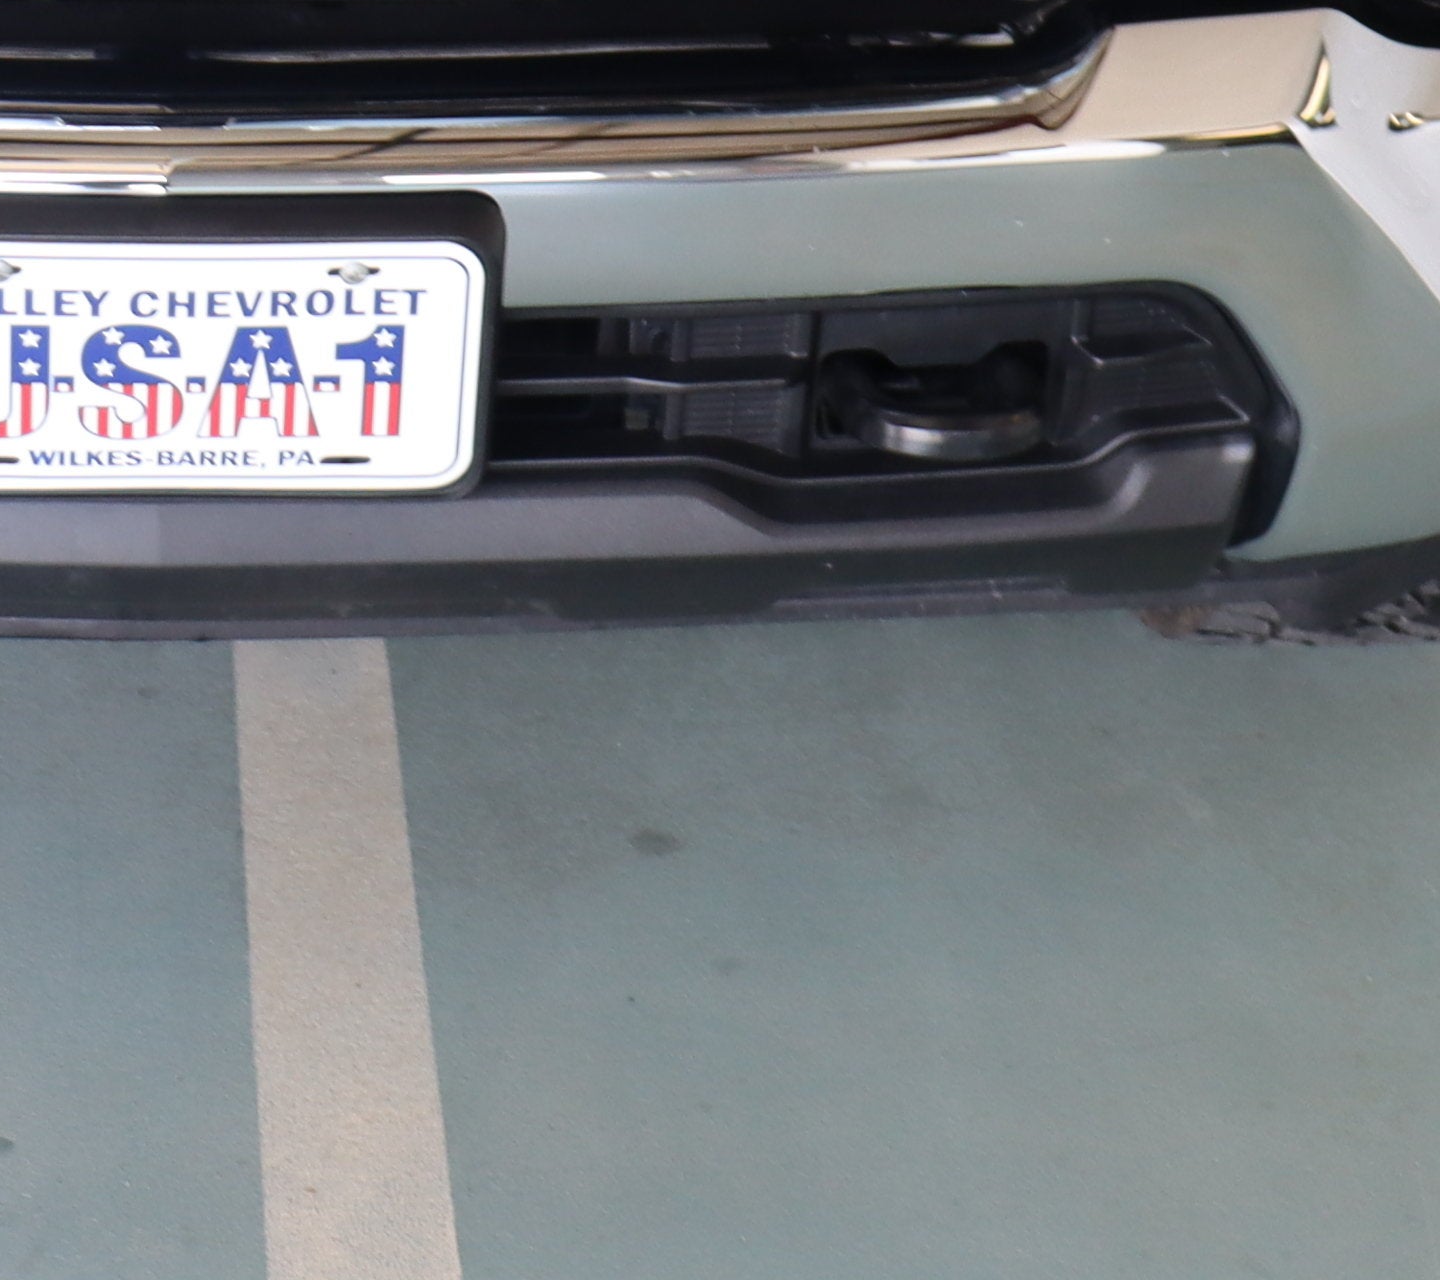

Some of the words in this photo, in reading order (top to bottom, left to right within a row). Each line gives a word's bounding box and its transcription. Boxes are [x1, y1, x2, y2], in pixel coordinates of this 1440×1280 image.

[130, 288, 428, 318] CHEVROLET
[29, 449, 266, 469] WILKES-BARRE,
[279, 450, 315, 467] PA
